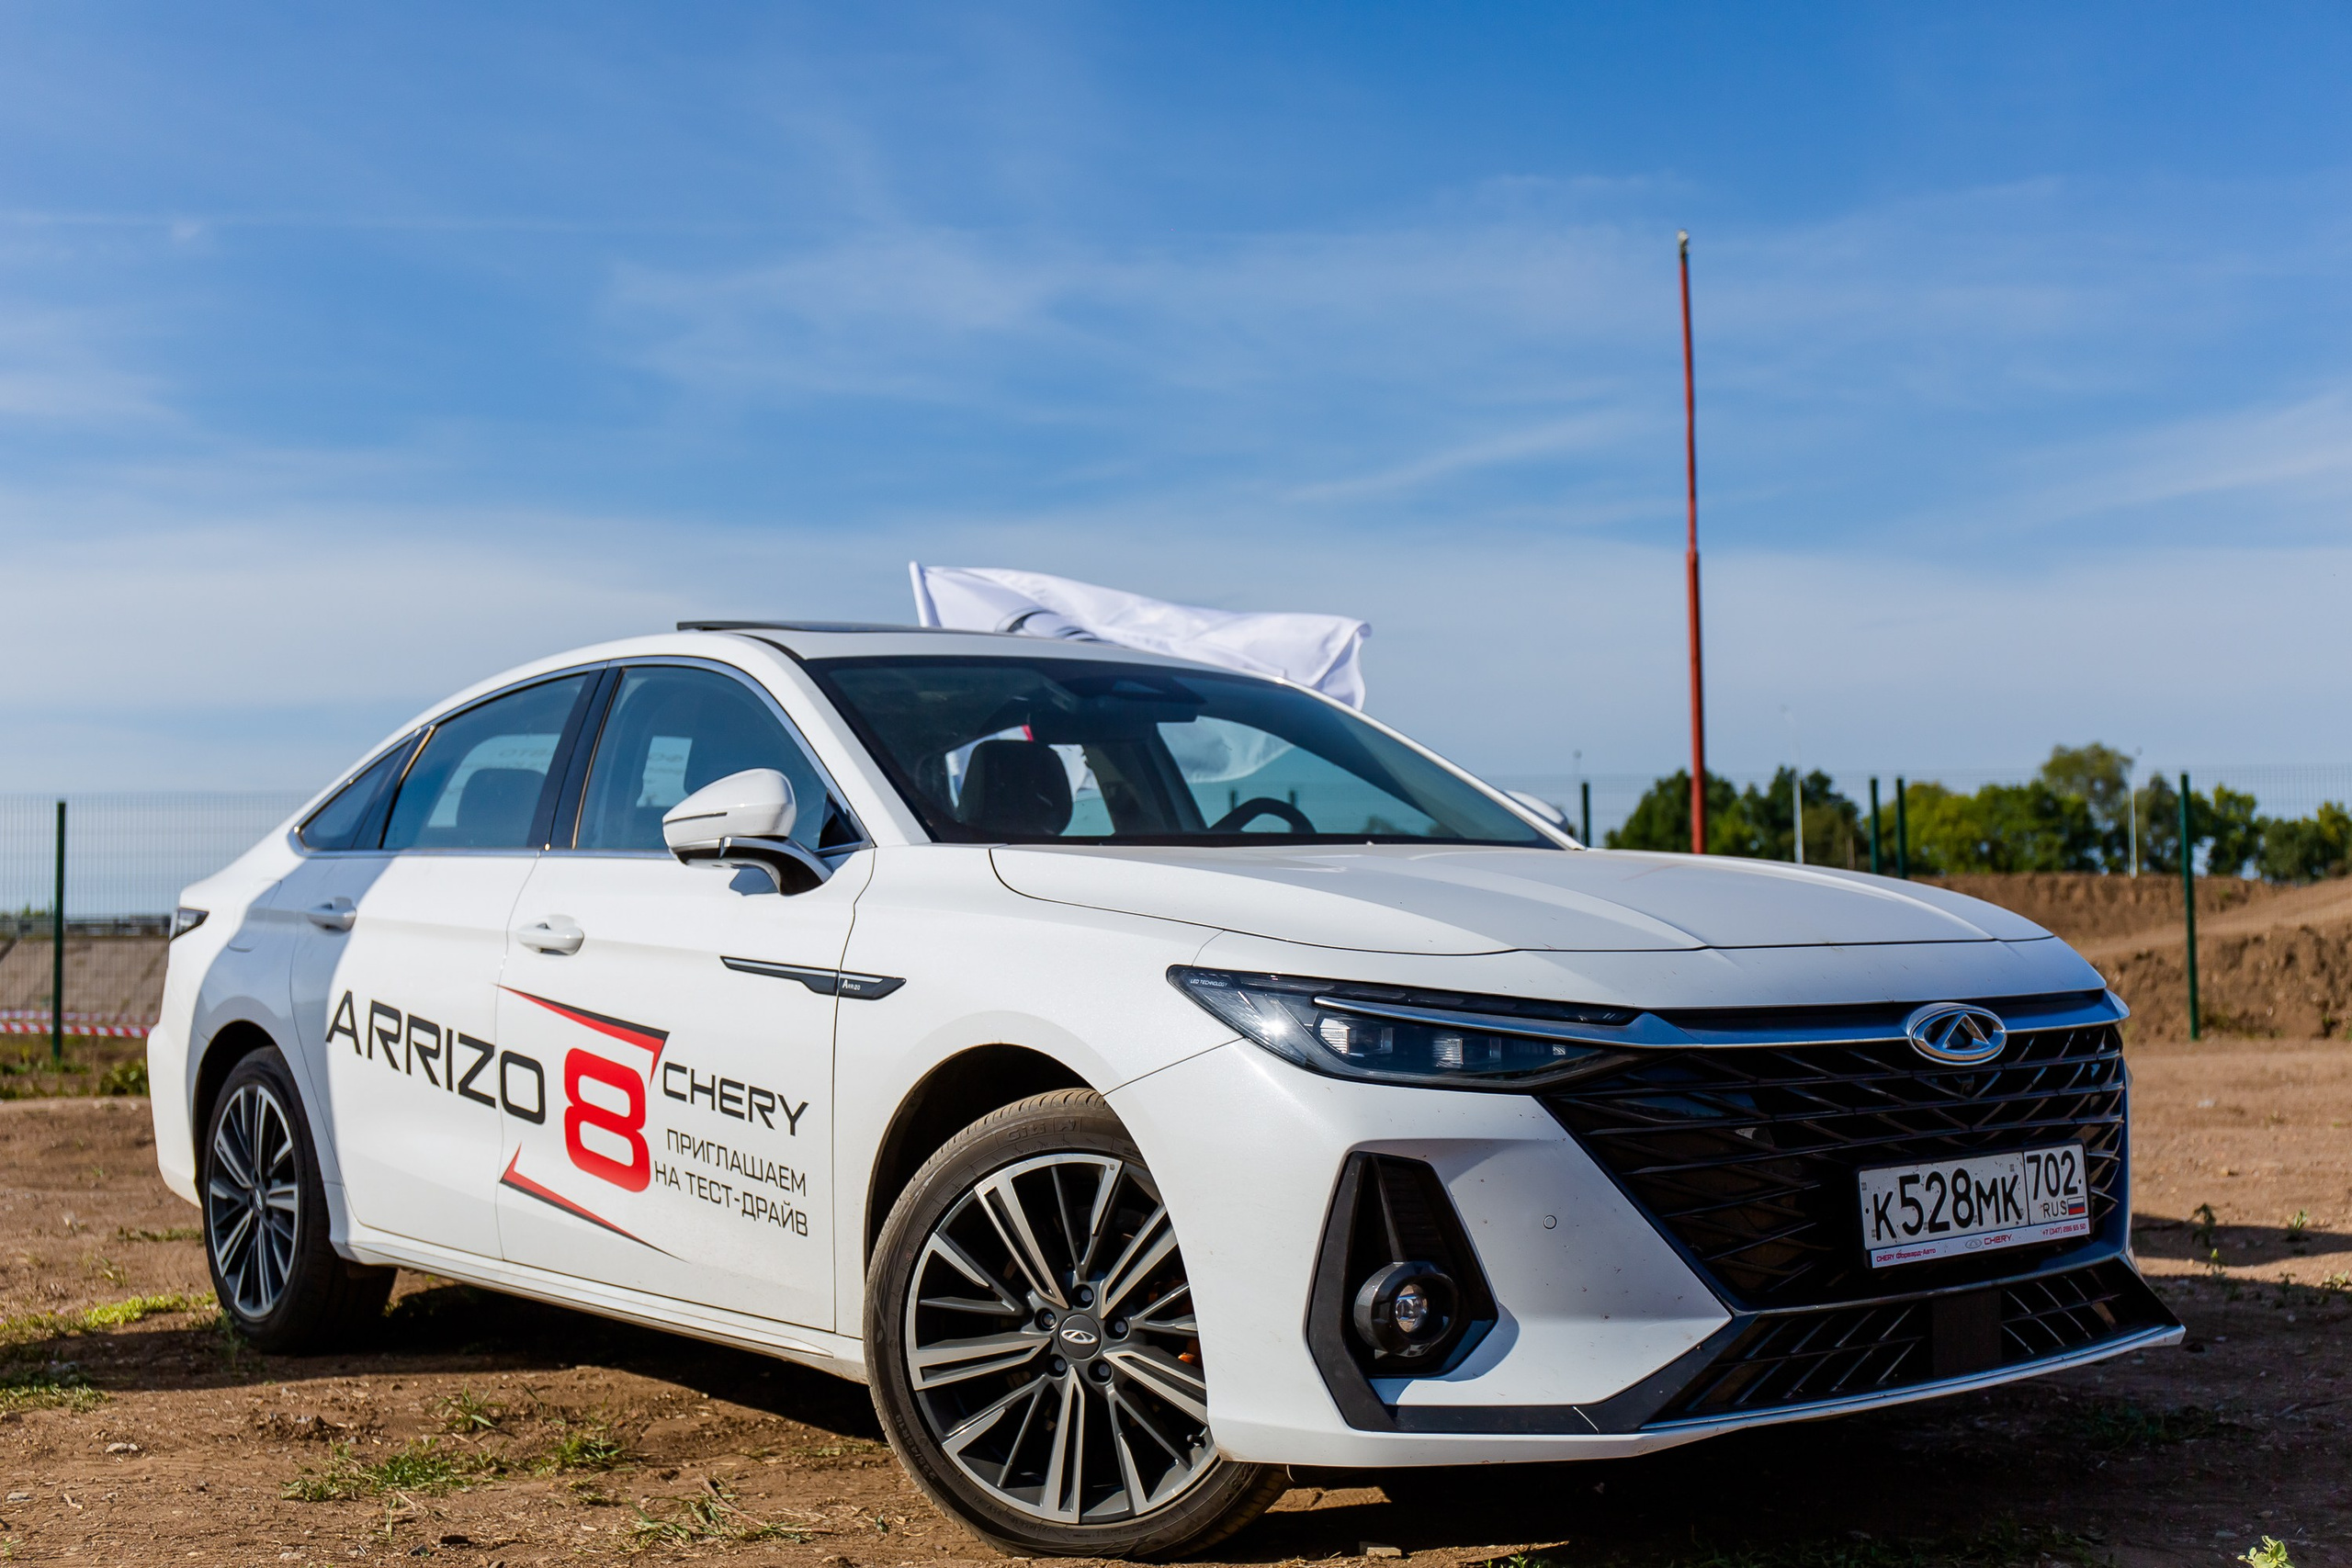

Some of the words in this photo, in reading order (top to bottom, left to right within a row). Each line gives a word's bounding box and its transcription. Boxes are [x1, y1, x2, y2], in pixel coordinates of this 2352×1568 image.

[326, 990, 546, 1125] ARRIZO
[564, 1047, 650, 1193] 8
[662, 1062, 809, 1136] CHERY
[667, 1128, 807, 1198] ПРИГЛАШАЕМ
[2027, 1150, 2078, 1201] 702
[655, 1161, 681, 1191] НА
[685, 1173, 809, 1237] ТЕСТ-ДРАЙВ
[2043, 1203, 2067, 1219] RUS
[1876, 1253, 1894, 1263] CHERY
[1984, 1234, 2012, 1246] CHERY
